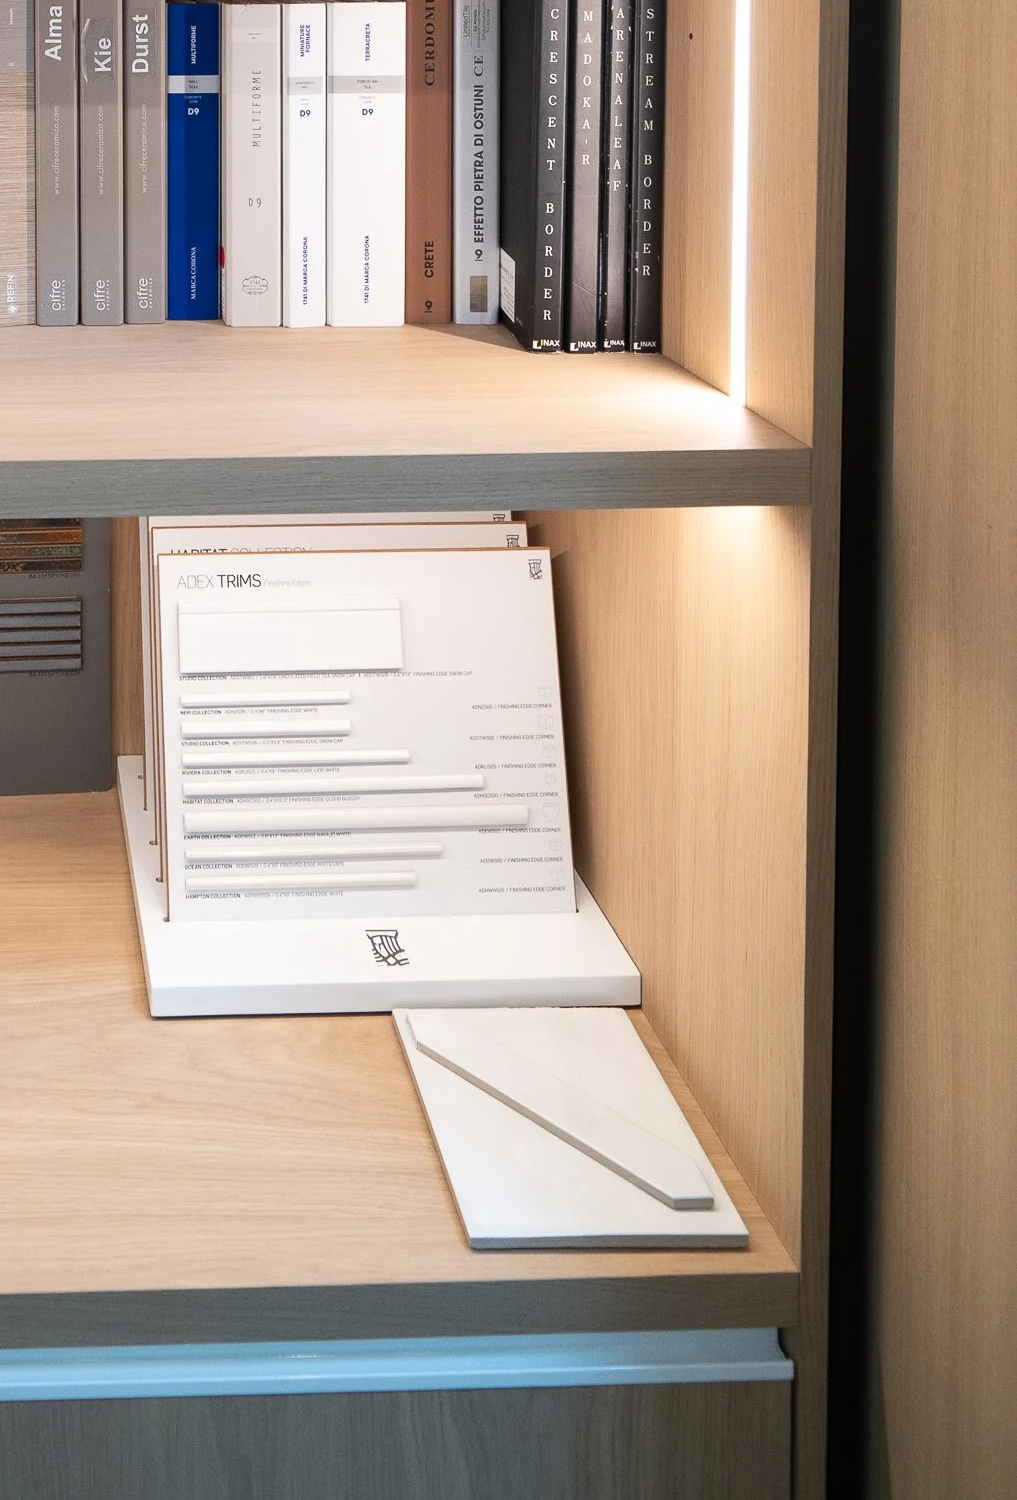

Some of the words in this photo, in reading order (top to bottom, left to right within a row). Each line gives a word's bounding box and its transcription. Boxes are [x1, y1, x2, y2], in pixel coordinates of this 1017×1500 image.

[45, 5, 62, 61] Alma
[95, 37, 113, 72] Kie
[132, 14, 149, 73] Durst
[547, 8, 559, 170] CRESCENT
[644, 8, 655, 131] STREAM
[252, 69, 262, 147] MULTIFORME
[473, 84, 484, 127] OSTUNI
[613, 8, 625, 191] ARENALEAF
[474, 130, 484, 139] DI
[474, 141, 484, 191] PIETRA
[474, 194, 484, 244] EFFETTO
[642, 155, 653, 276] BORDER
[425, 241, 434, 278] CRETE
[543, 203, 555, 321] BORDER
[7, 275, 15, 302] REFIN
[52, 280, 61, 311] cifre
[96, 280, 106, 311] cifre
[139, 277, 148, 309] cifre
[177, 575, 214, 589] ADEX
[217, 574, 261, 588] TRIMS
